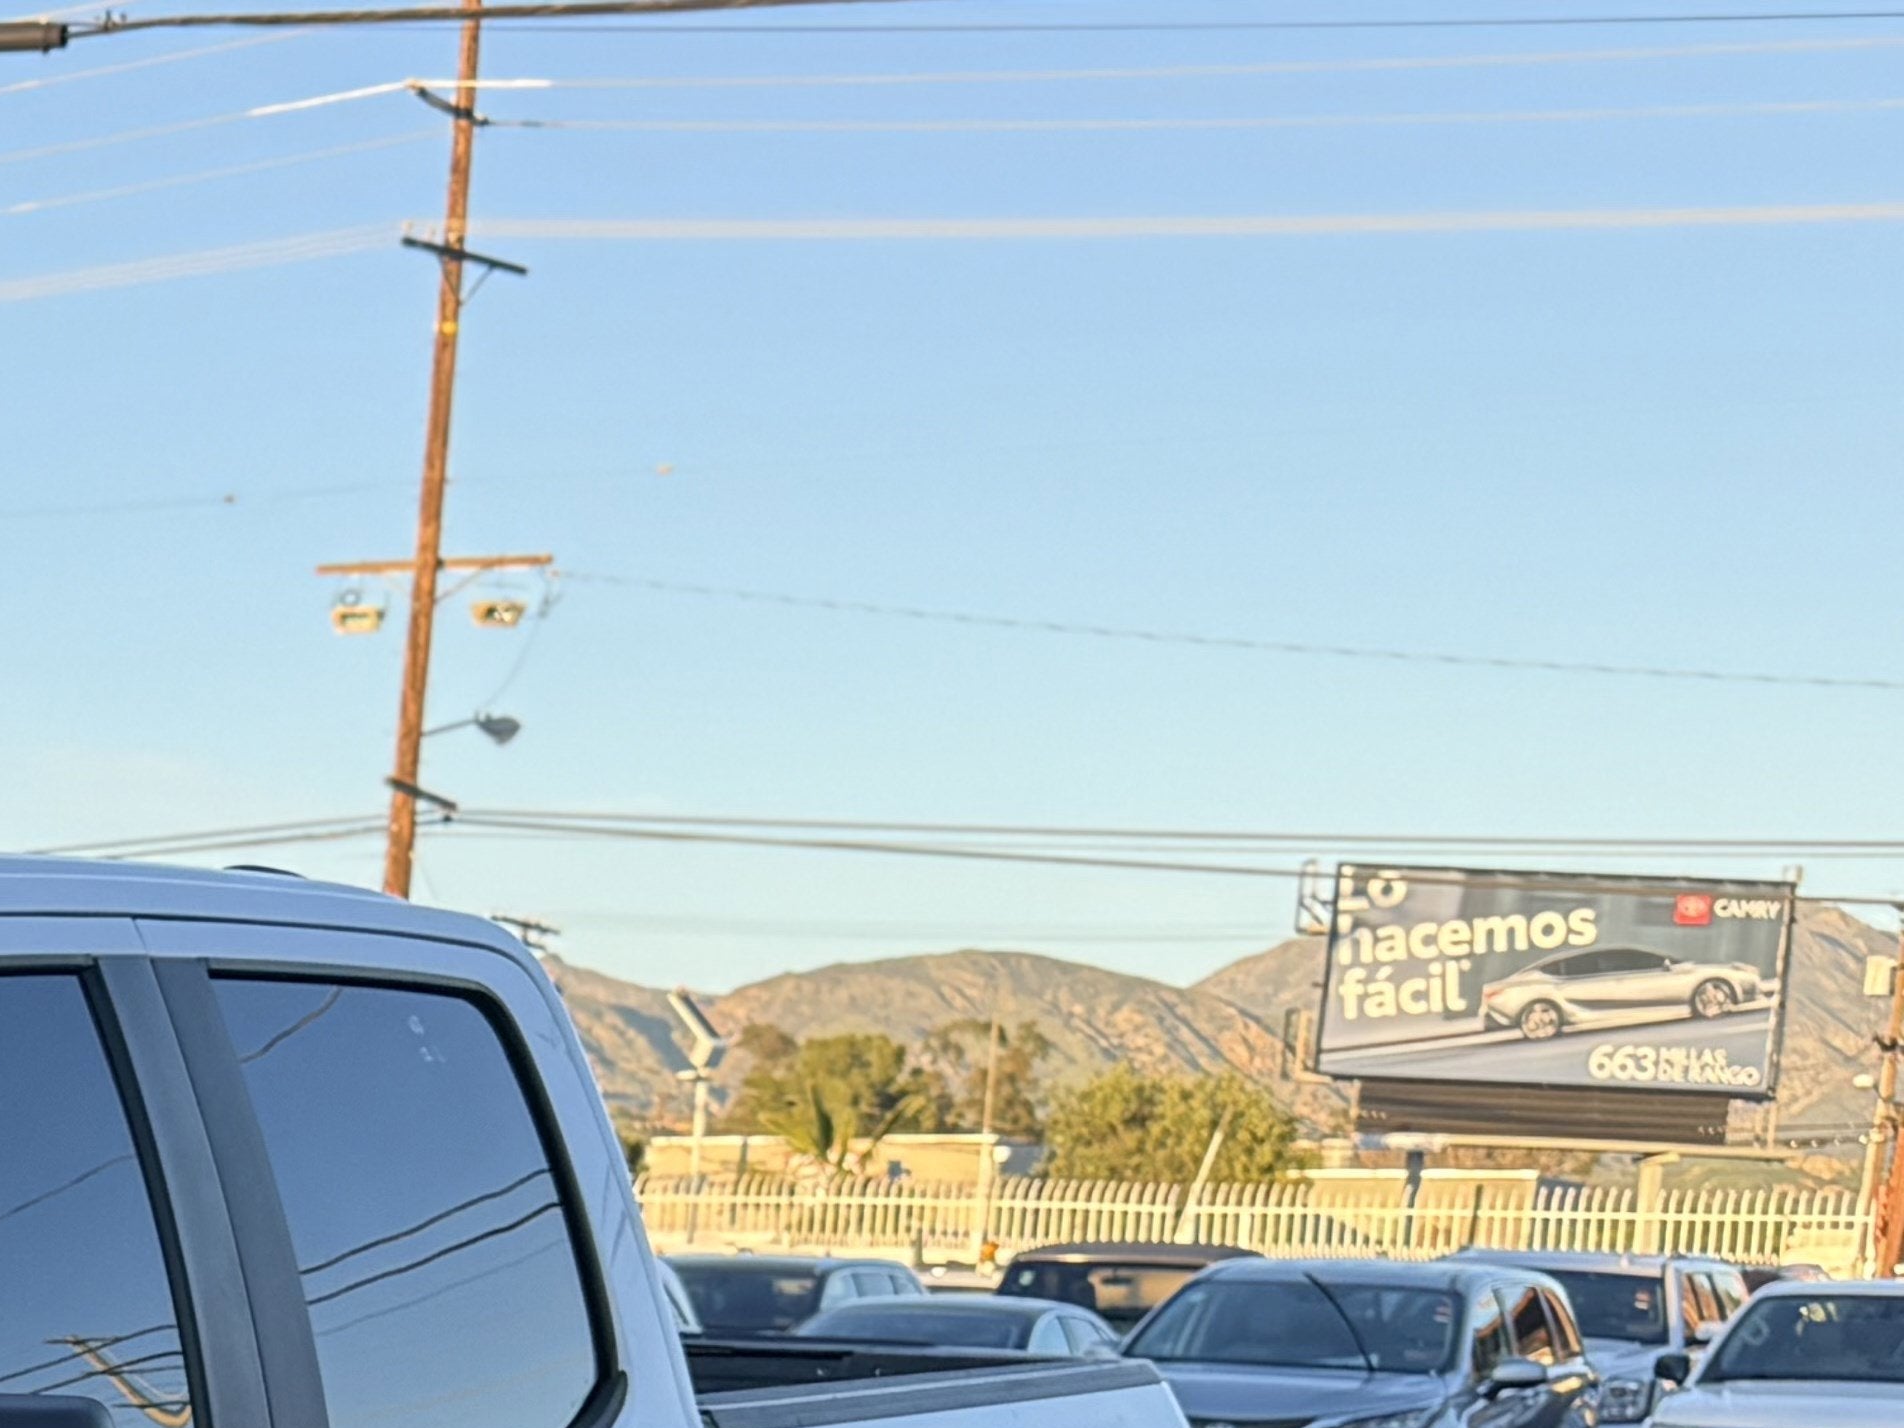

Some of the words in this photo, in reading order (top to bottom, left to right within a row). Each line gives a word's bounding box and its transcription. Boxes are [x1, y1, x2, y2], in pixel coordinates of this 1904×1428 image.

[1337, 865, 1408, 911] Lo
[1337, 906, 1598, 966] hacemos
[1588, 1044, 1657, 1081] 663
